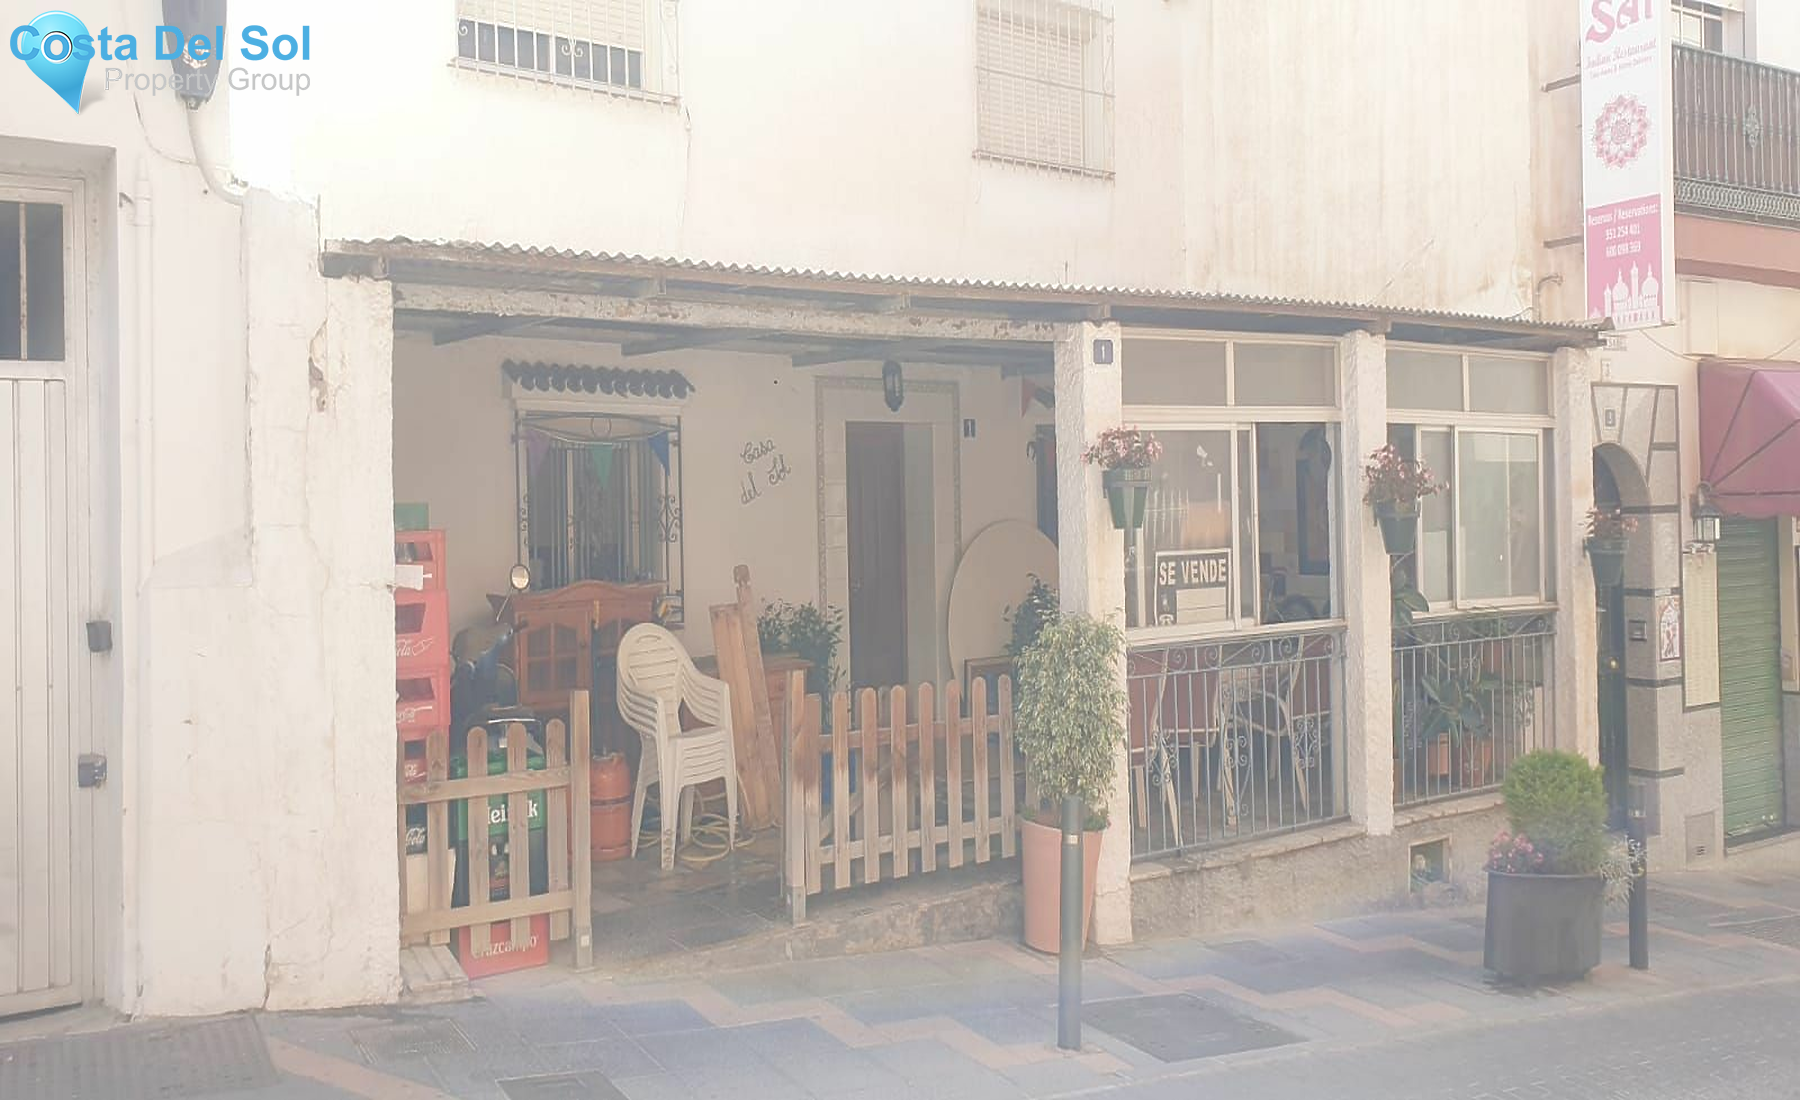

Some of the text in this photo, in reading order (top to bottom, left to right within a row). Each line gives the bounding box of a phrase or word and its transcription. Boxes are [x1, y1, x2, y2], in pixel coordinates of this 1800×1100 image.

[740, 439, 776, 464] Casa
[741, 453, 791, 505] del Sol
[1159, 558, 1227, 586] SE VENDE
